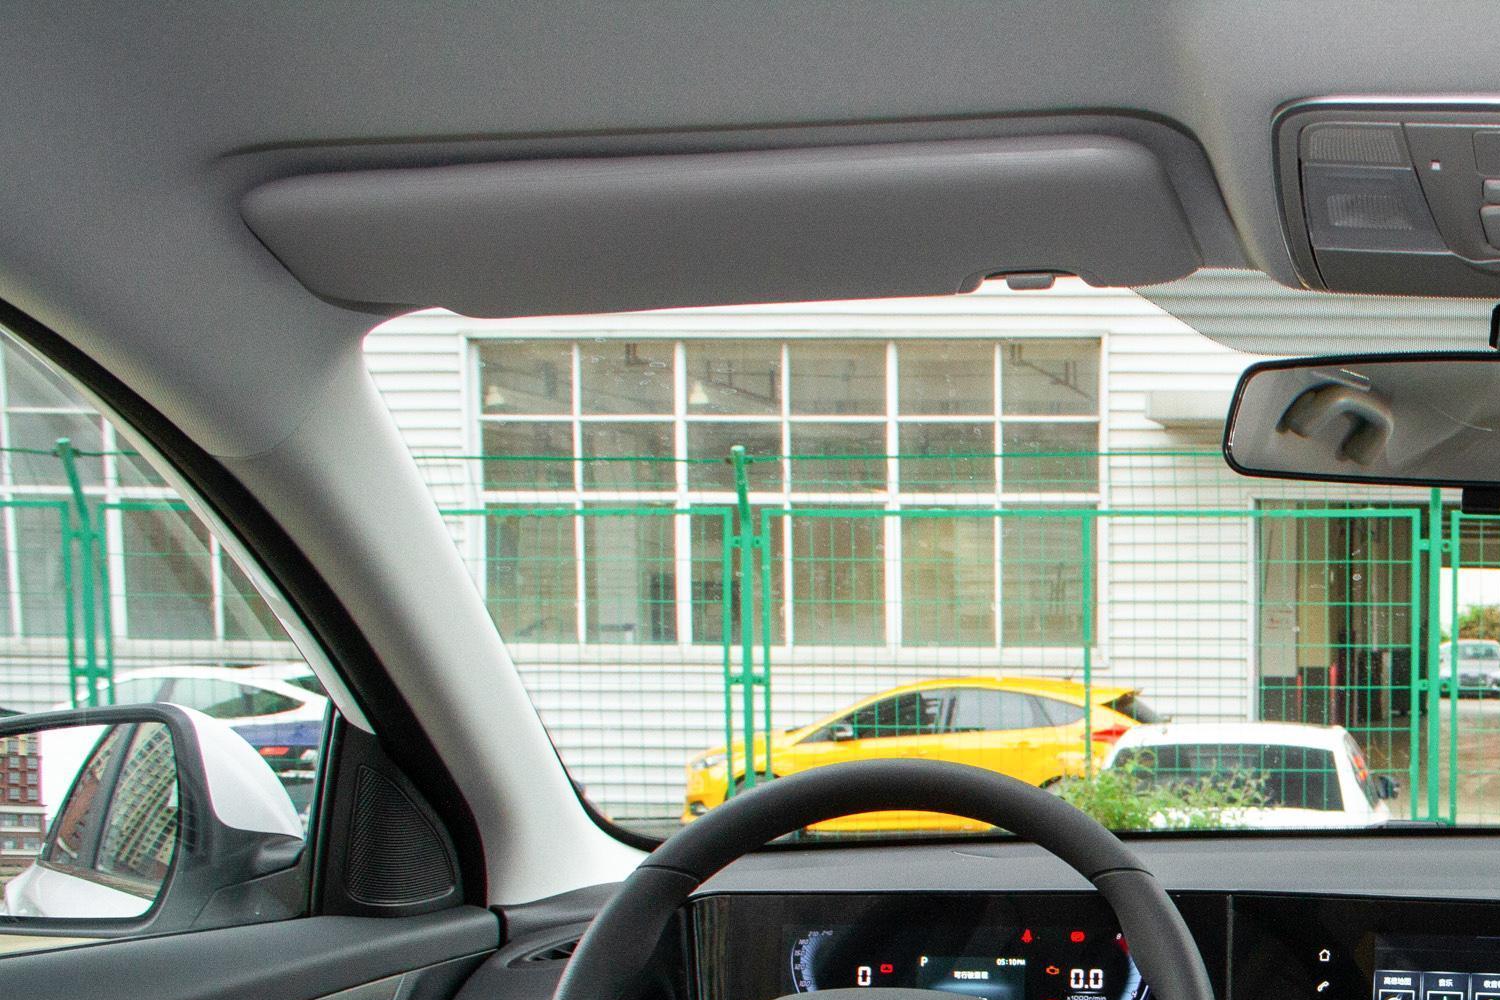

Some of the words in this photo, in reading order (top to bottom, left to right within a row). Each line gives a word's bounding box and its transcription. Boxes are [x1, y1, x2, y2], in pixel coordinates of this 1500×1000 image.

[920, 956, 928, 967] P
[857, 966, 872, 986] 0
[1070, 968, 1103, 989] 0.0
